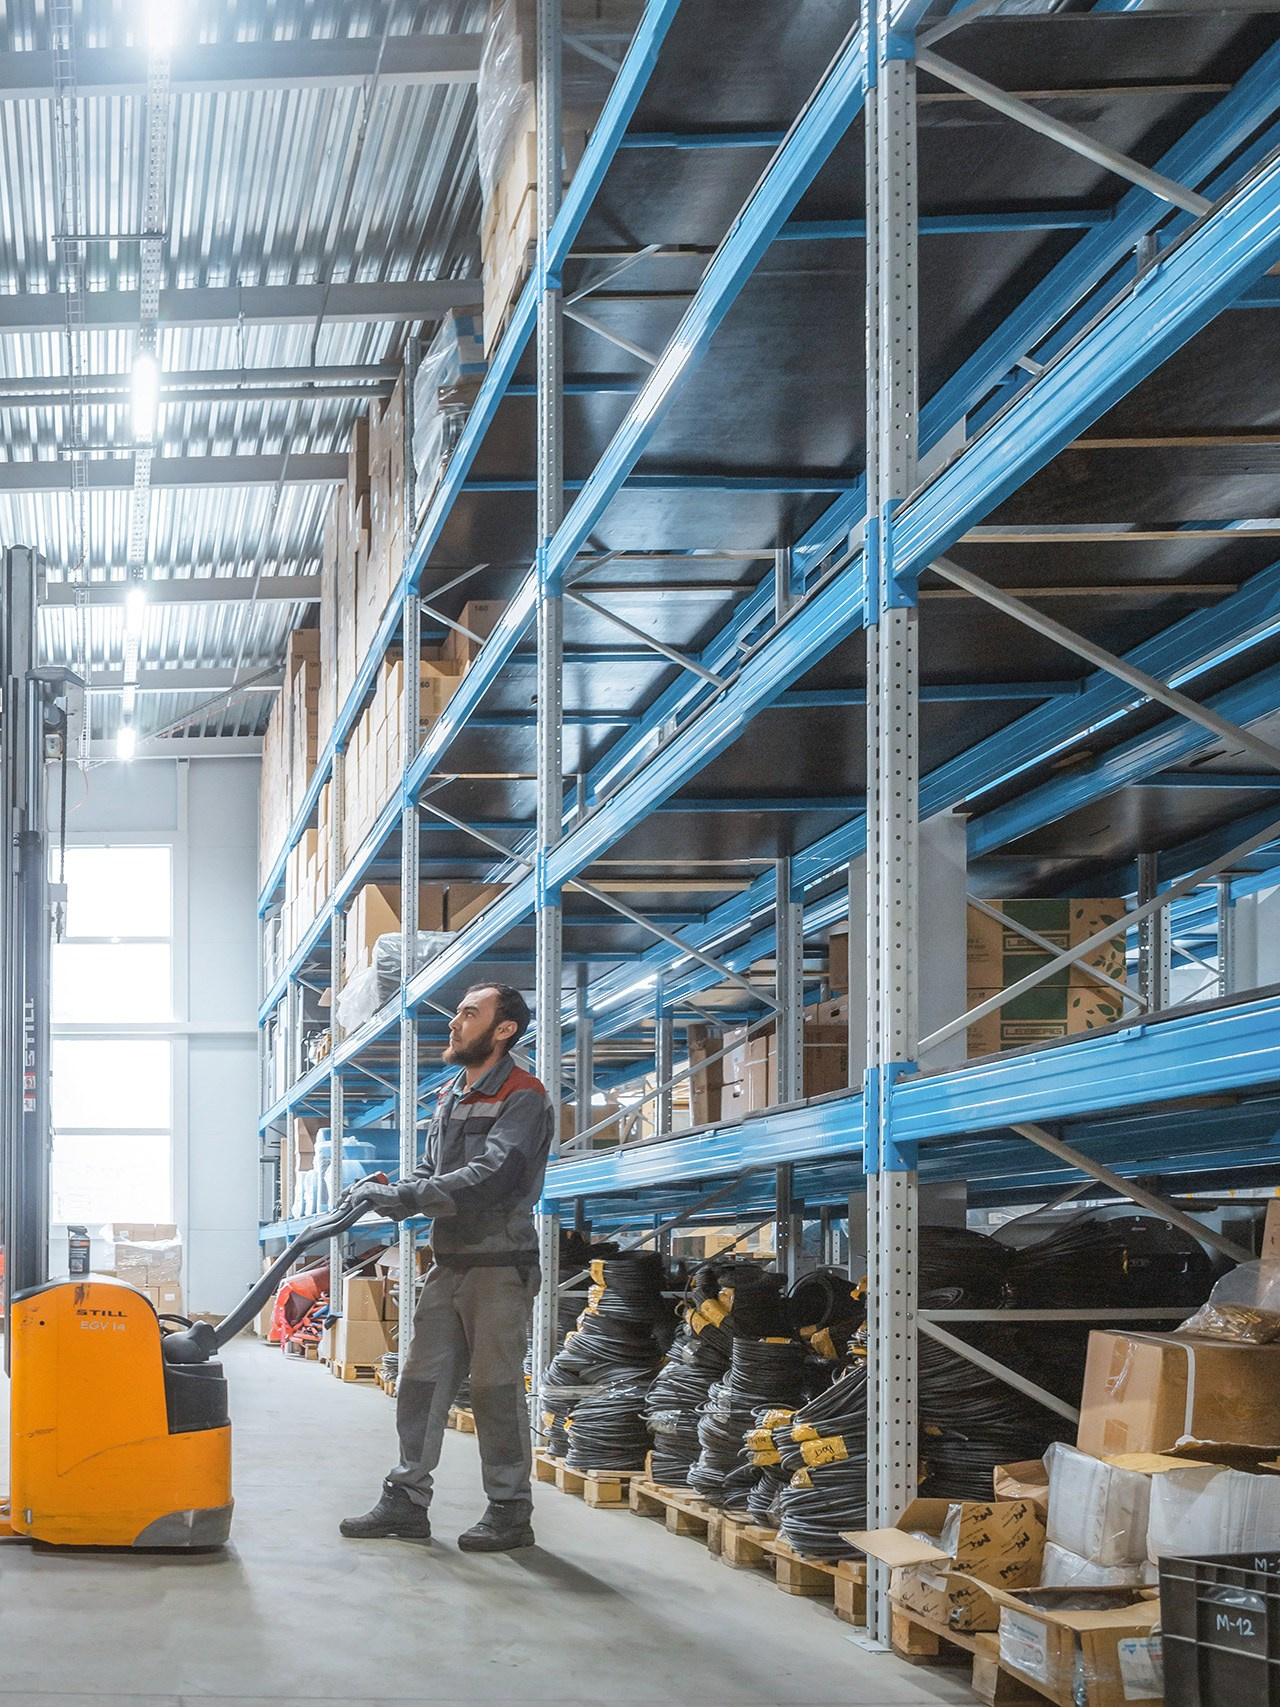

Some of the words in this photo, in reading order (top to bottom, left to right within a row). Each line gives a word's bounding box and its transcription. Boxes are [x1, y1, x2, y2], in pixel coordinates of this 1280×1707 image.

[24, 997, 35, 1067] STILL
[76, 1309, 129, 1318] STILL
[80, 1321, 110, 1331] EGV
[1216, 1613, 1256, 1636] M-12
